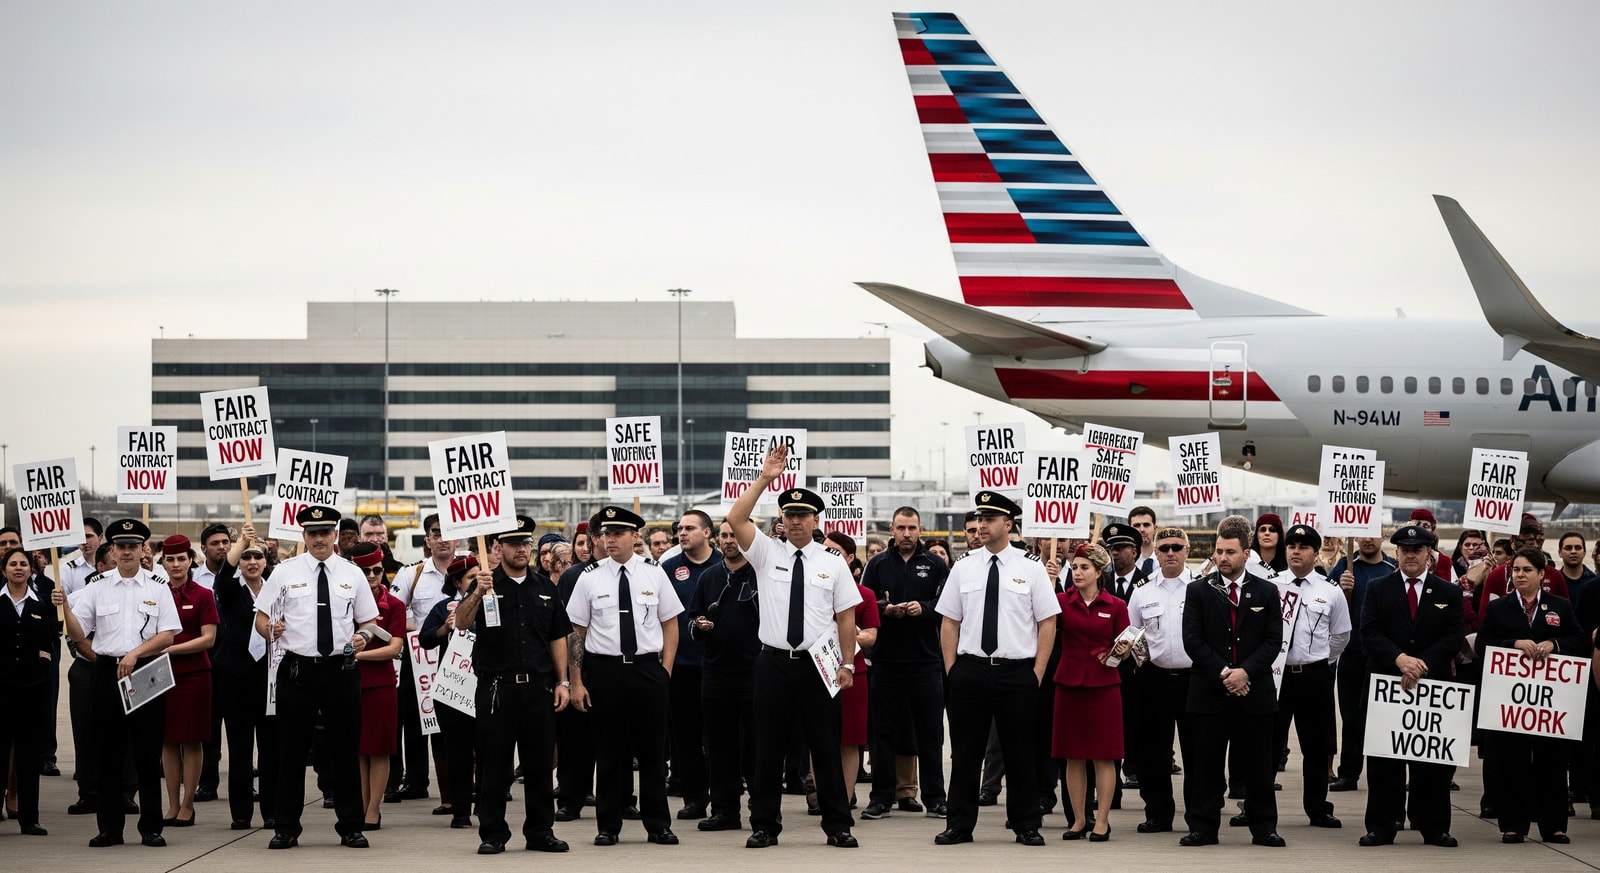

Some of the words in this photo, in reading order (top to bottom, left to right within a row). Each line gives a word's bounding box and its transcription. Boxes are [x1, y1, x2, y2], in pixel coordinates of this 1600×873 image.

[214, 395, 257, 422] FAIR
[128, 431, 166, 452] FAIR
[208, 420, 268, 441] CONTRACT
[615, 422, 652, 443] SAFE
[977, 428, 1015, 450] FAIR
[218, 437, 263, 465] NOW
[769, 435, 795, 455] AIR
[1179, 441, 1209, 458] SAFE
[120, 454, 174, 469] CONTRACT
[445, 441, 494, 474] FAIR
[734, 452, 760, 467] SAFE
[970, 451, 1025, 467] CONTRACT
[1096, 448, 1124, 466] SAFE
[1182, 457, 1209, 472] SAFE
[26, 465, 66, 492] FAIR
[126, 470, 167, 490] NOW
[290, 458, 334, 487] FAIR
[979, 466, 1019, 488] NOW
[1037, 457, 1079, 482] FAIR
[1481, 462, 1516, 486] FAIR
[437, 469, 507, 496] CONTRACT
[1027, 483, 1089, 501] CONTRACT
[1471, 483, 1522, 502] CONTRACT
[20, 489, 77, 512] CONTRACT
[277, 483, 340, 506] CONTRACT
[831, 493, 855, 507] SAFE
[449, 490, 502, 524] NOW
[1034, 501, 1079, 524] NOW
[1333, 504, 1372, 524] NOW
[1474, 498, 1514, 521] NOW
[30, 508, 71, 535] NOW
[1490, 651, 1587, 684] RESPECT
[1374, 678, 1471, 711] RESPECT
[1511, 682, 1554, 708] OUR
[1402, 709, 1442, 734] OUR
[1500, 704, 1567, 736] WORK
[1390, 731, 1456, 762] WORK
